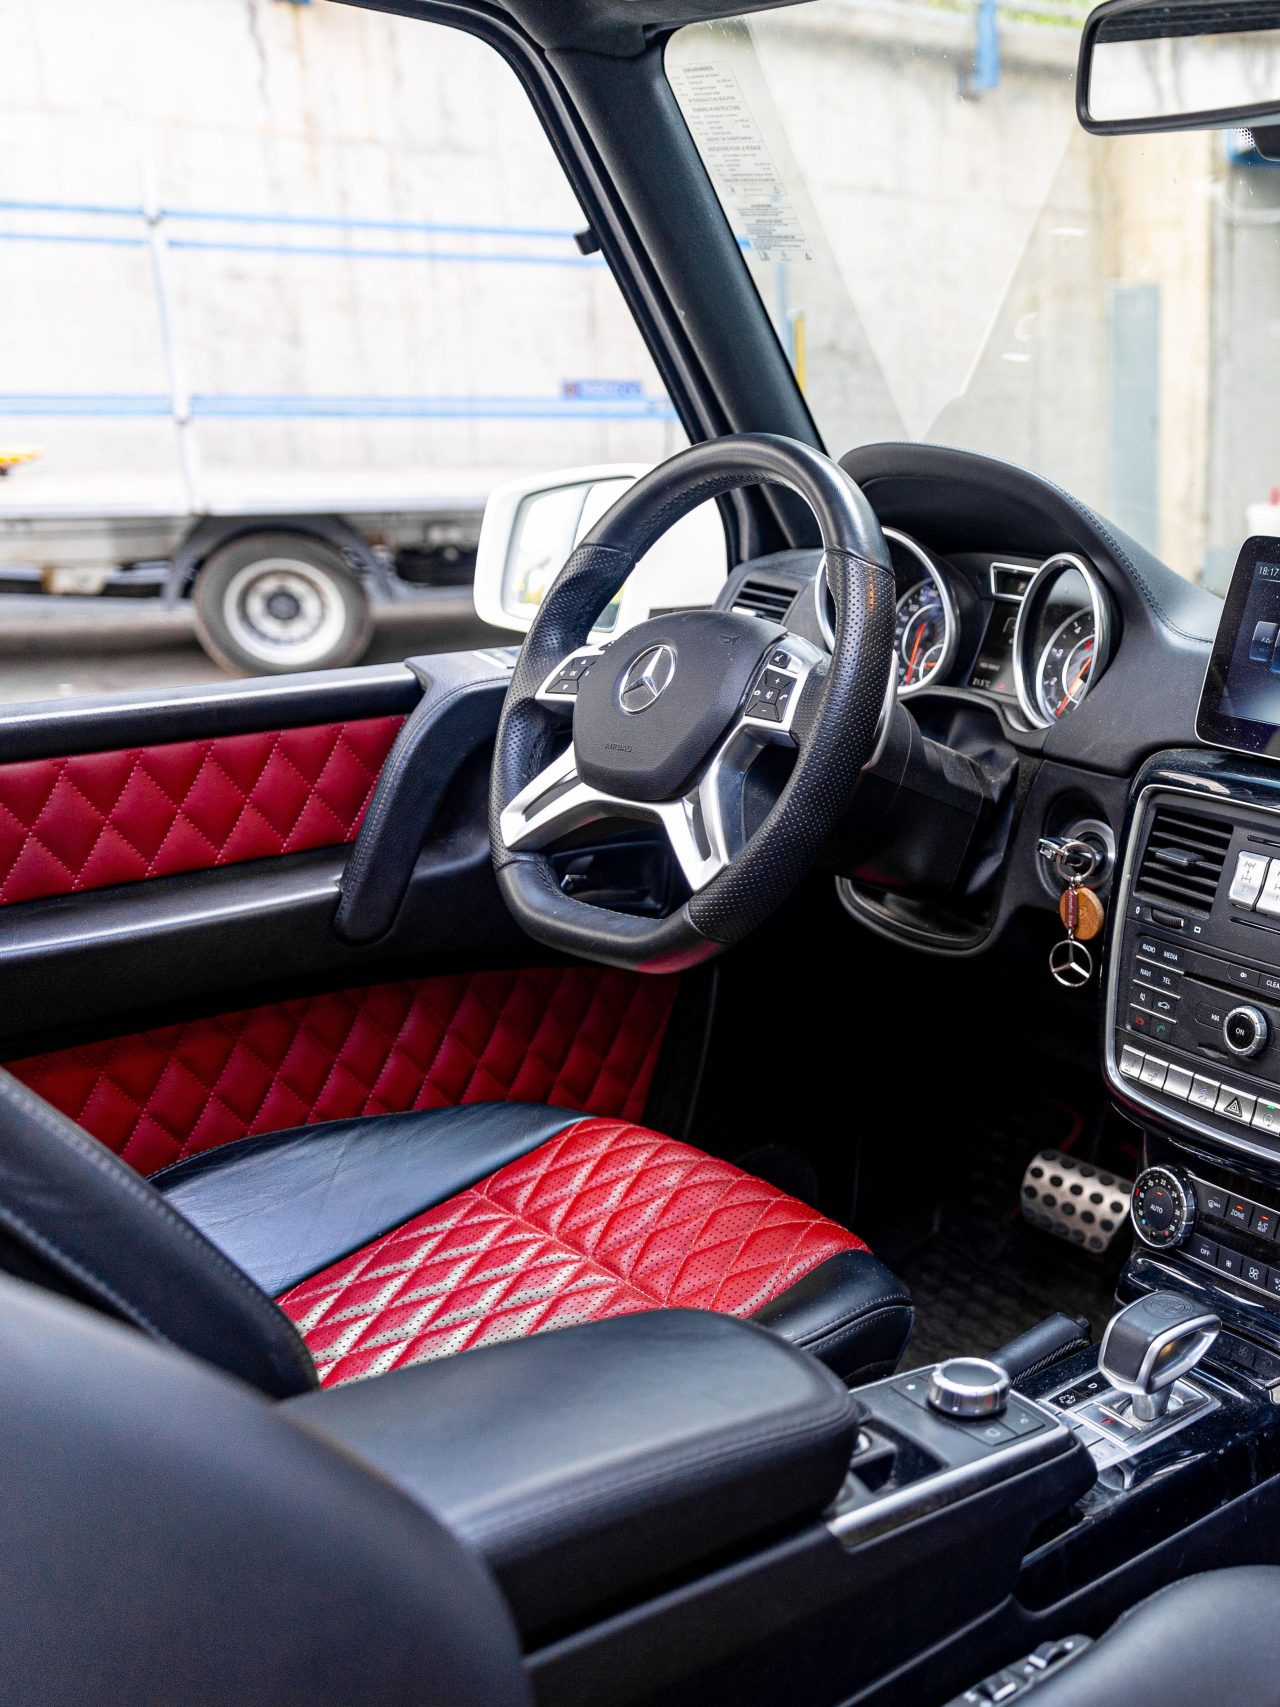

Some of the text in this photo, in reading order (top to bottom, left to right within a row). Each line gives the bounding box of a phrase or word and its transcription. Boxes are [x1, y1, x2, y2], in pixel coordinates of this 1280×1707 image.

[1259, 566, 1279, 577] 18:17
[1142, 943, 1156, 954] RADIO
[1163, 950, 1178, 961] MEDIA
[1140, 968, 1151, 978] NAVI
[1162, 976, 1172, 986] TEL
[1235, 1027, 1246, 1037] ON
[1150, 1204, 1164, 1214] AUTO
[1230, 1208, 1245, 1220] ZONE
[1258, 1220, 1269, 1230] A/C
[1200, 1247, 1210, 1257] OFF
